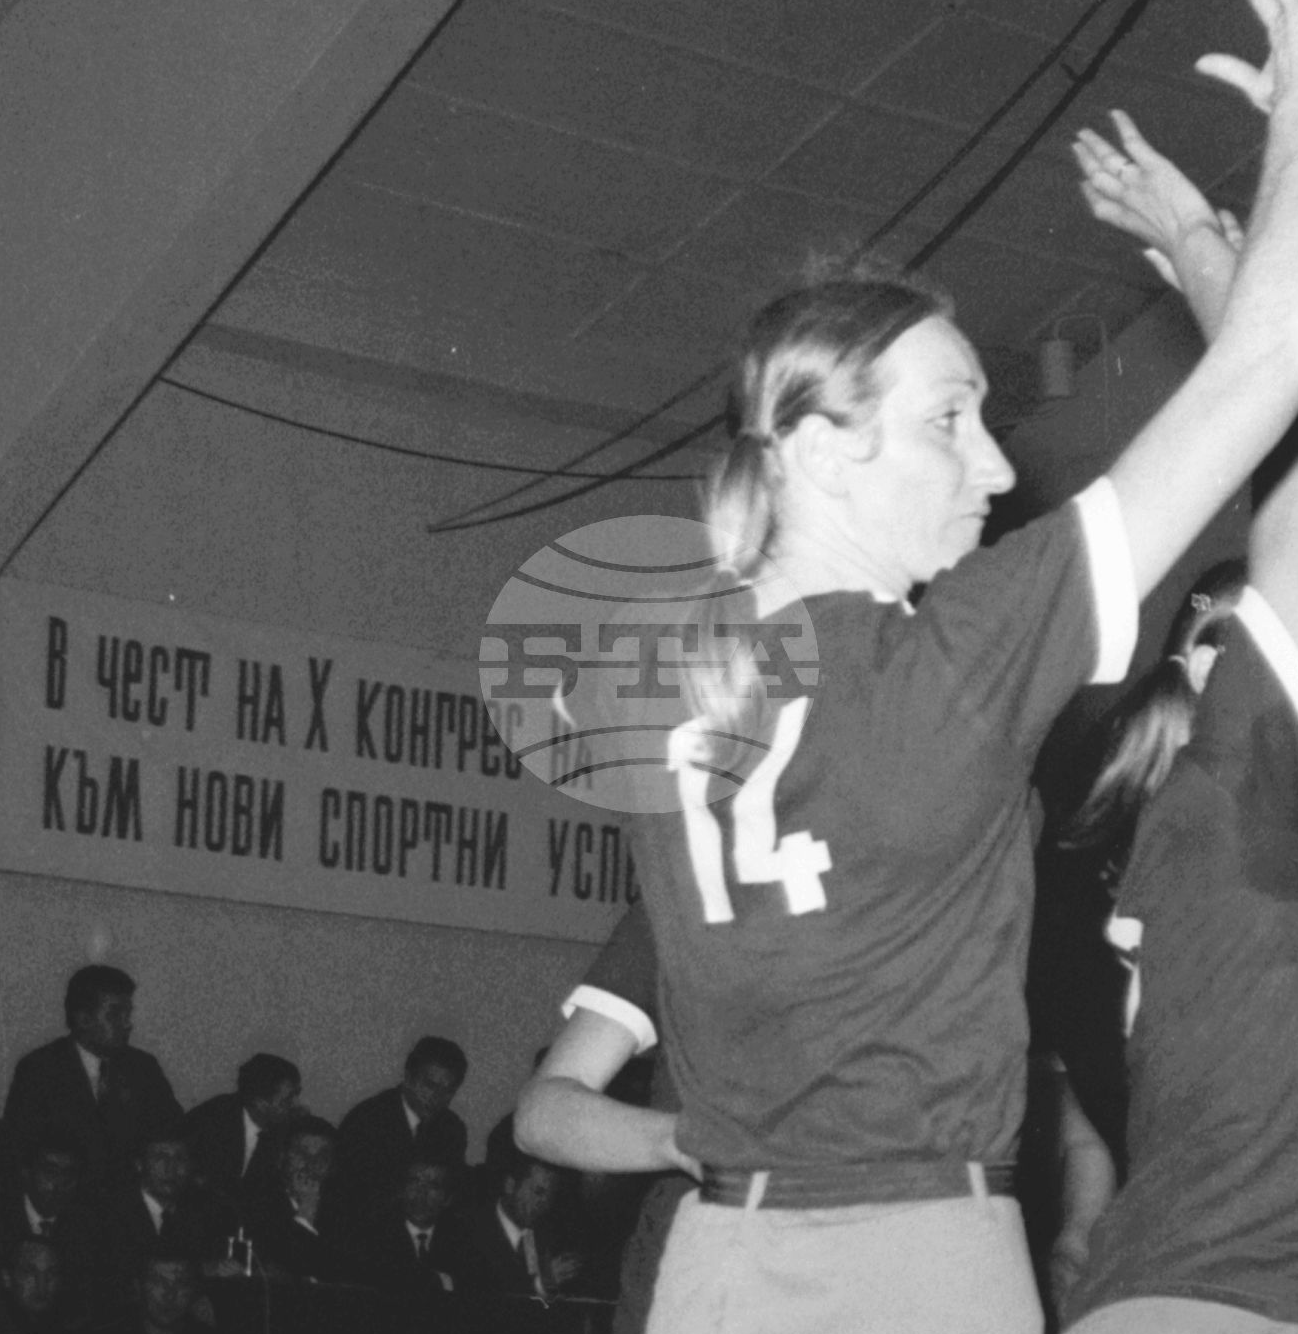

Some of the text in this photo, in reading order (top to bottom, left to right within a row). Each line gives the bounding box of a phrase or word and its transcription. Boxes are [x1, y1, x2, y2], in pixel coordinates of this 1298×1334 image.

[45, 615, 69, 710] В
[97, 634, 211, 732] ЧЕСТ
[236, 658, 287, 748] НА
[355, 677, 524, 780] КОНГРЕС
[43, 745, 142, 842] КЪМ
[175, 766, 284, 862] НОВИ
[319, 787, 508, 892] СПОРТНИ
[668, 696, 833, 924] 14
